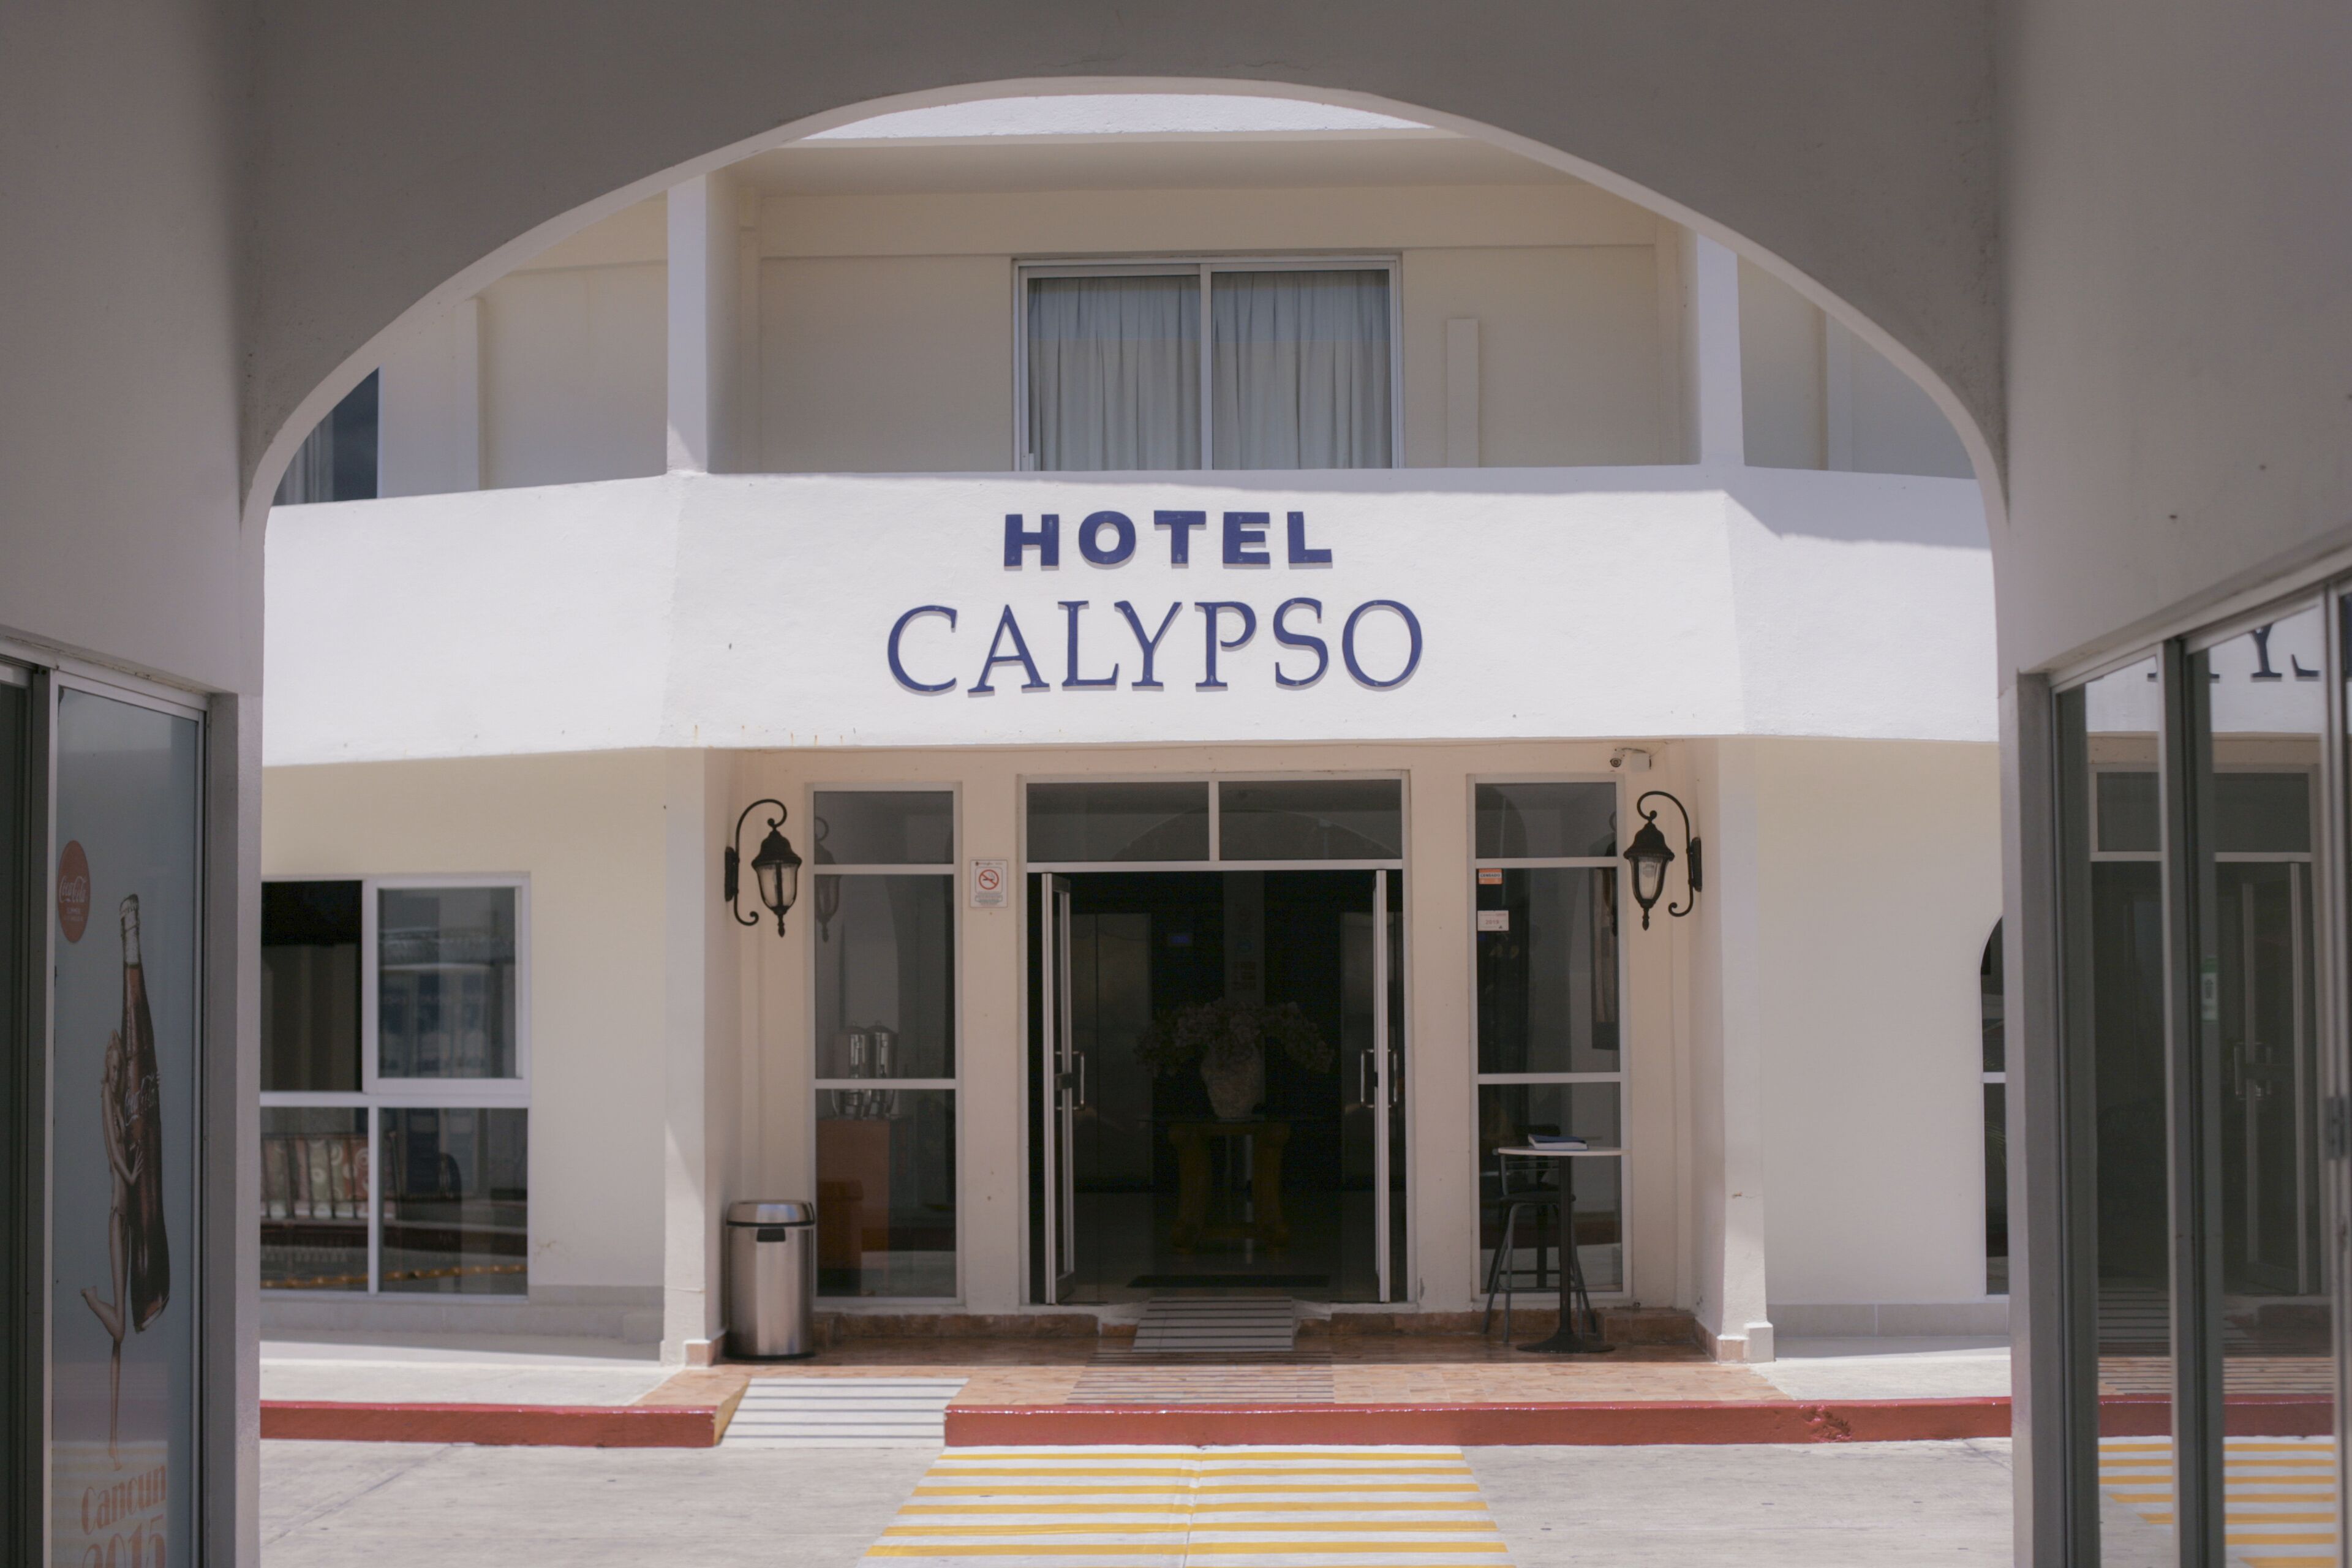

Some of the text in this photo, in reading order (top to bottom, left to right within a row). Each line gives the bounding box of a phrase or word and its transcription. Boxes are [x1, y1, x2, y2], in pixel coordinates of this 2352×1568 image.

[1004, 510, 1333, 568] HOTEL
[887, 597, 1423, 693] CALYPSO
[82, 1466, 166, 1535] Cancun
